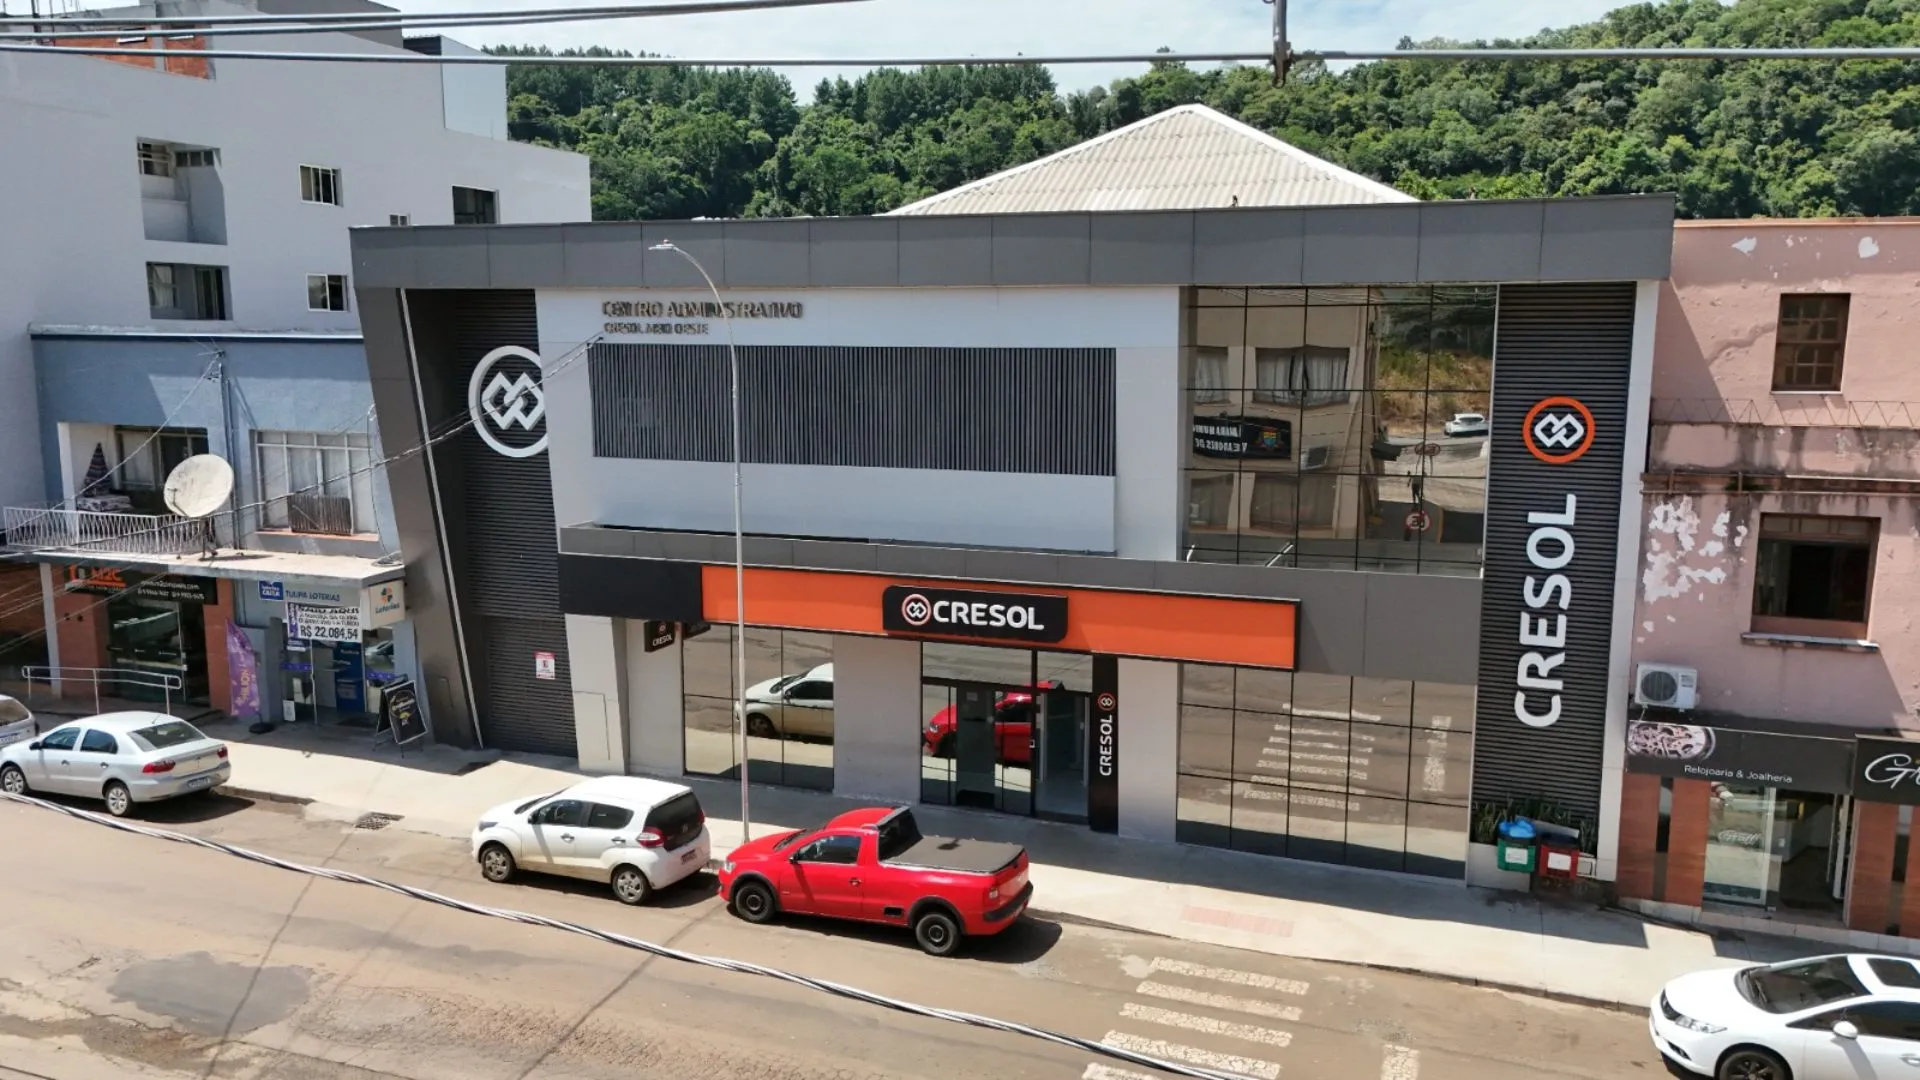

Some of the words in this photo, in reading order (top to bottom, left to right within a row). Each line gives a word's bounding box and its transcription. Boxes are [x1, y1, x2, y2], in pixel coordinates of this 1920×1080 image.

[602, 301, 663, 318] CENTRO
[667, 301, 804, 318] ADMINISTRATIVO
[309, 593, 341, 601] LOTERIAS
[933, 600, 1045, 630] CRESOL
[1514, 493, 1577, 728] CRESOL
[652, 633, 673, 647] CRESOL
[1099, 714, 1114, 777] CRESOL
[1684, 764, 1734, 778] Relojoaria
[1735, 769, 1744, 780] &
[1746, 771, 1793, 784] Joalheria
